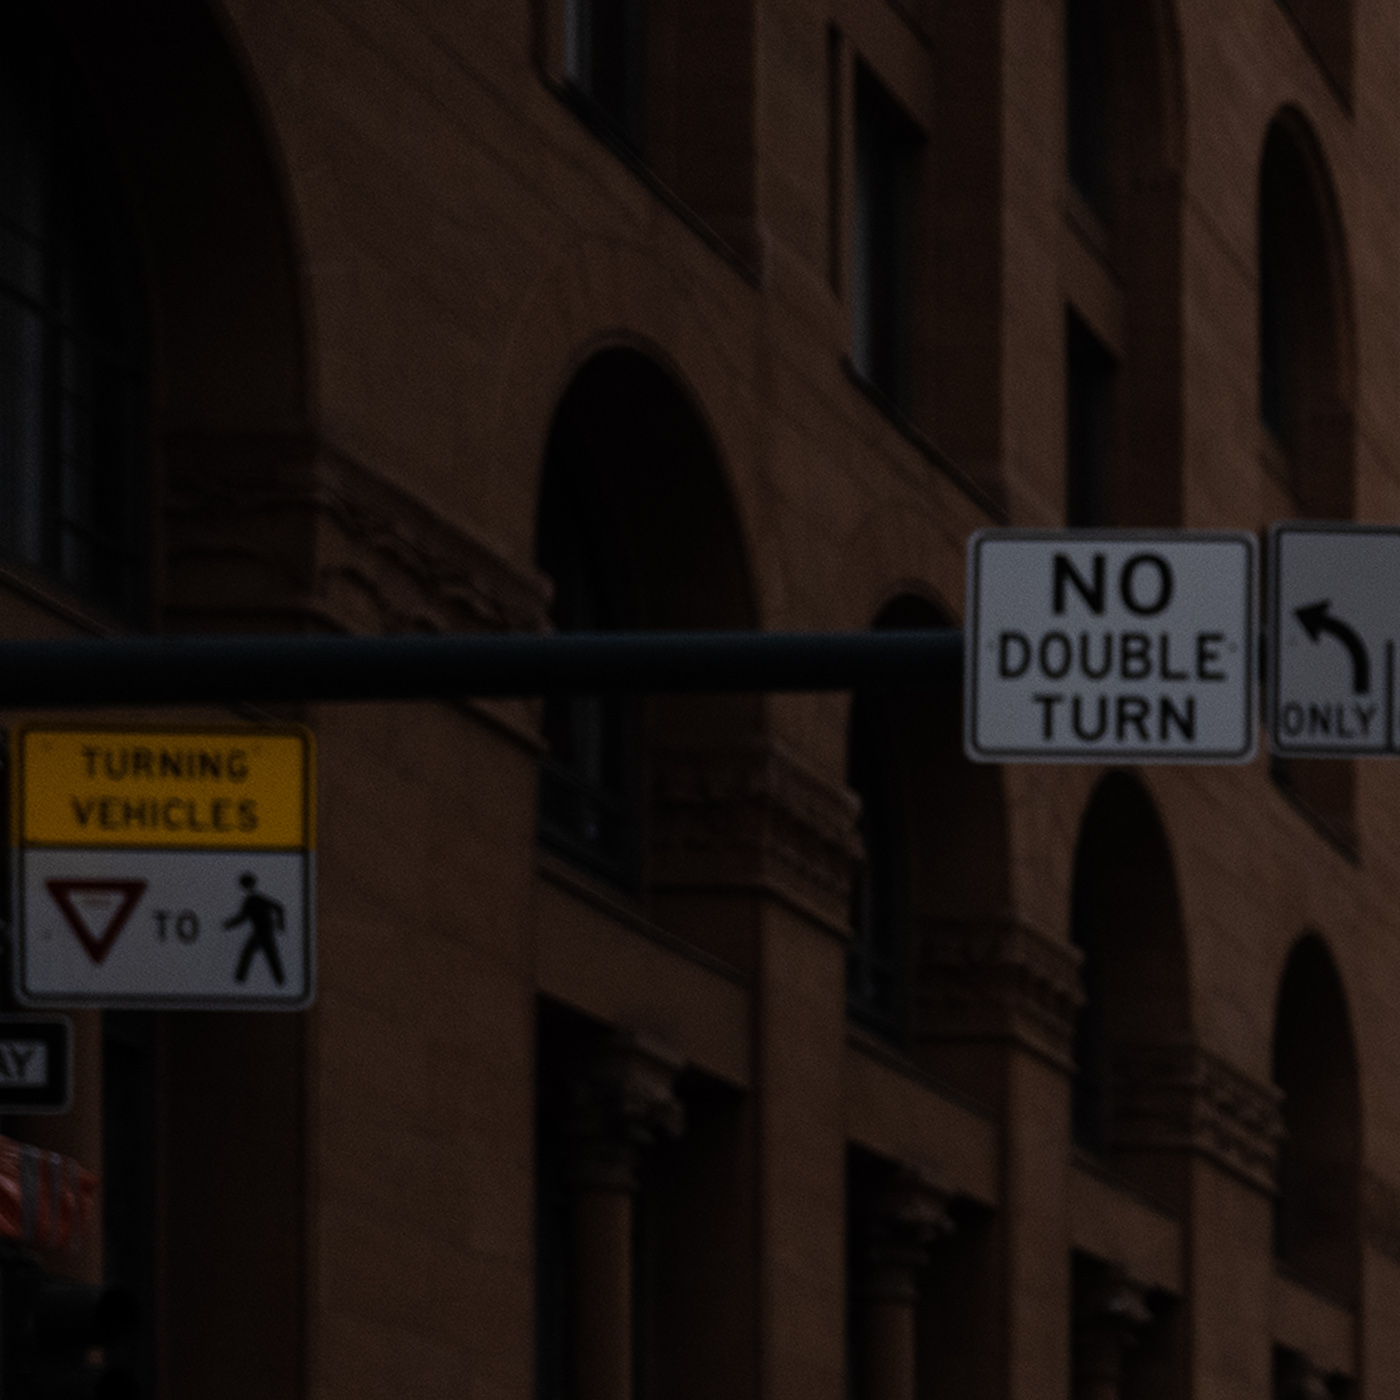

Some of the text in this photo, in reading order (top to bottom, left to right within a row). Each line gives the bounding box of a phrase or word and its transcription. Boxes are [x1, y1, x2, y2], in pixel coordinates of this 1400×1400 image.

[1051, 552, 1174, 616] NO
[998, 630, 1227, 682] DOUBLE
[1031, 693, 1198, 743] TURN
[1282, 703, 1377, 739] ONLY
[81, 745, 251, 781] TURNING
[71, 796, 259, 832] VEHICLES
[152, 908, 200, 944] TO
